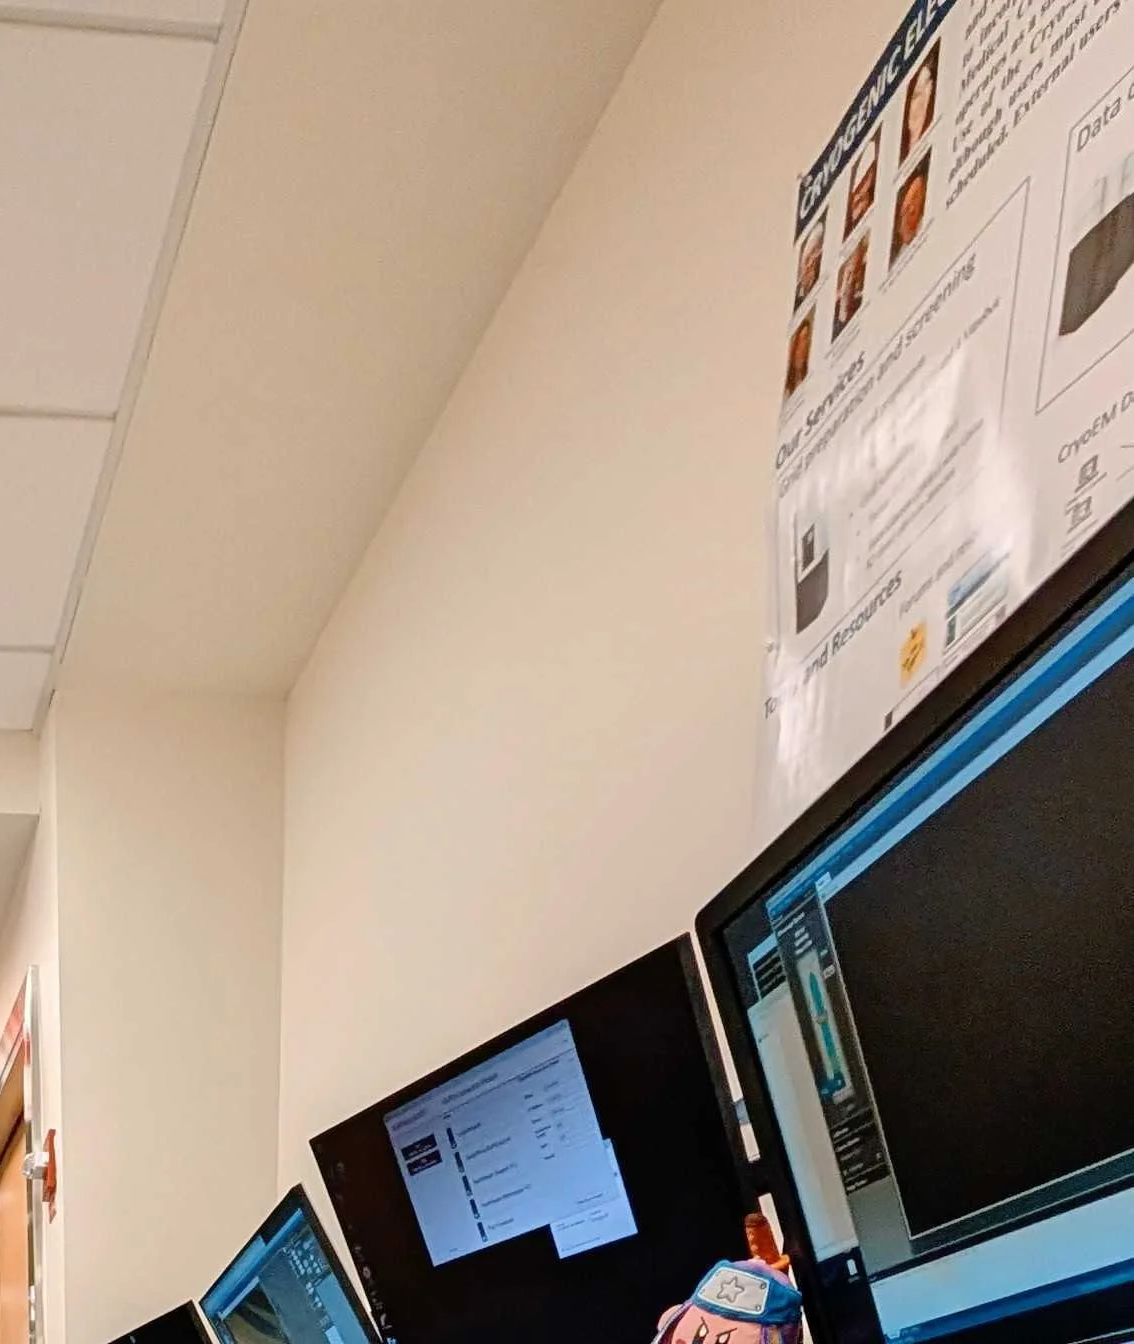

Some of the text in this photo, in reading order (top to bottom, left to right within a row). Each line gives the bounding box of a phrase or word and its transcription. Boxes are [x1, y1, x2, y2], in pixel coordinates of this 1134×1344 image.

[1014, 42, 1076, 128] External
[1079, 0, 1122, 50] users
[800, 43, 902, 220] CRYOGENIC
[1077, 96, 1123, 153] Data
[1057, 399, 1120, 465] CryoEM
[802, 570, 903, 686] and Resources
